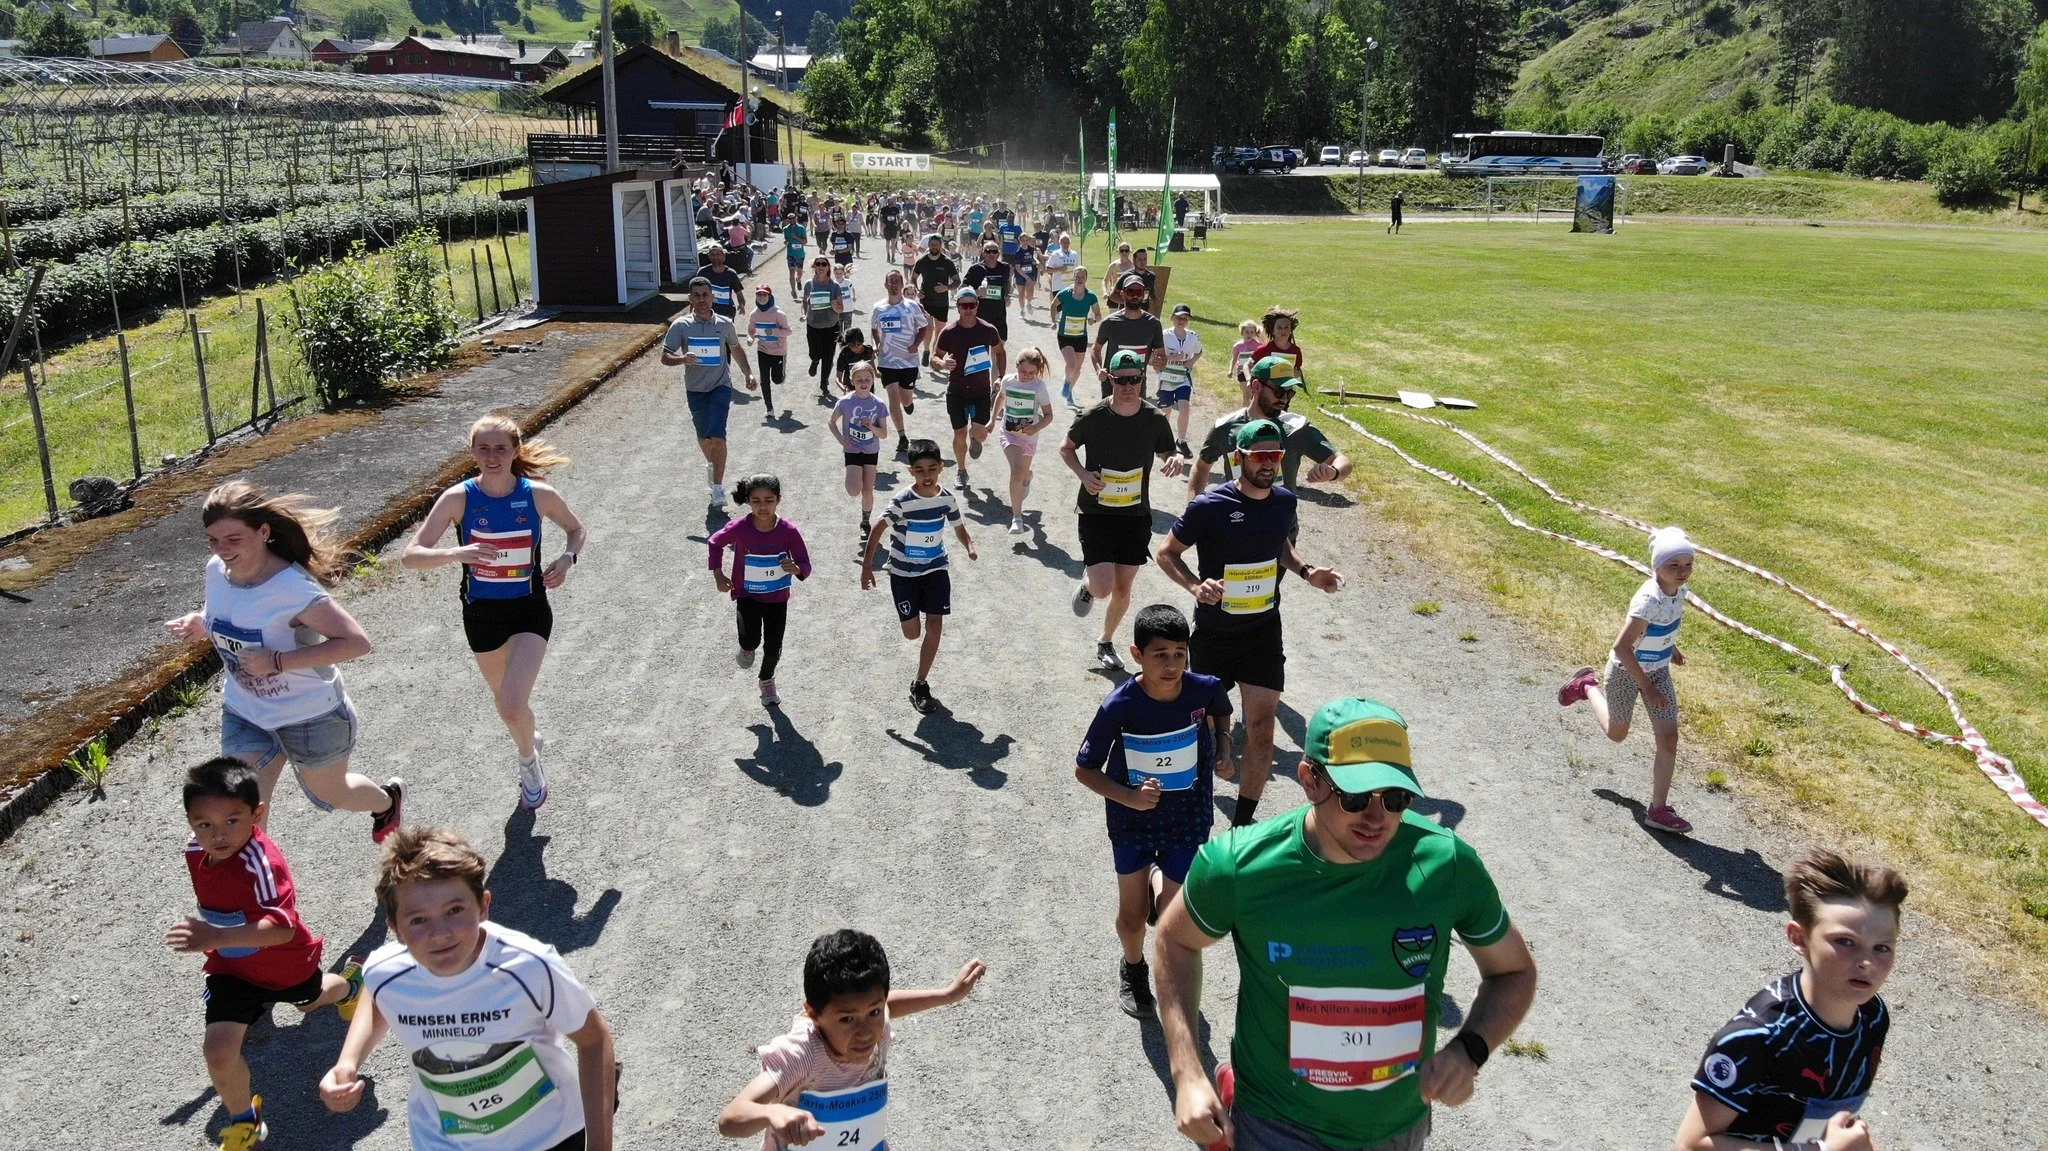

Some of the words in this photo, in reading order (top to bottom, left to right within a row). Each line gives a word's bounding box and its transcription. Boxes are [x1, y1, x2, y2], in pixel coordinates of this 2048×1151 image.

[867, 156, 912, 167] START
[924, 535, 935, 543] 20
[496, 550, 509, 559] 04
[764, 569, 775, 577] 18
[1245, 584, 1260, 593] 219
[1155, 756, 1173, 767] 22
[1295, 1002, 1317, 1012] Mot
[1320, 1004, 1351, 1014] Nilen
[1353, 1006, 1379, 1016] sine
[397, 1013, 457, 1027] MENSEN
[460, 1008, 512, 1024] ERNST
[422, 1026, 486, 1039] MINNELØP
[1340, 1030, 1372, 1047] 301
[1308, 1068, 1349, 1078] FRESVIK
[1308, 1076, 1354, 1084] PRODUKT
[467, 1093, 504, 1113] 126
[837, 1127, 861, 1147] 24
